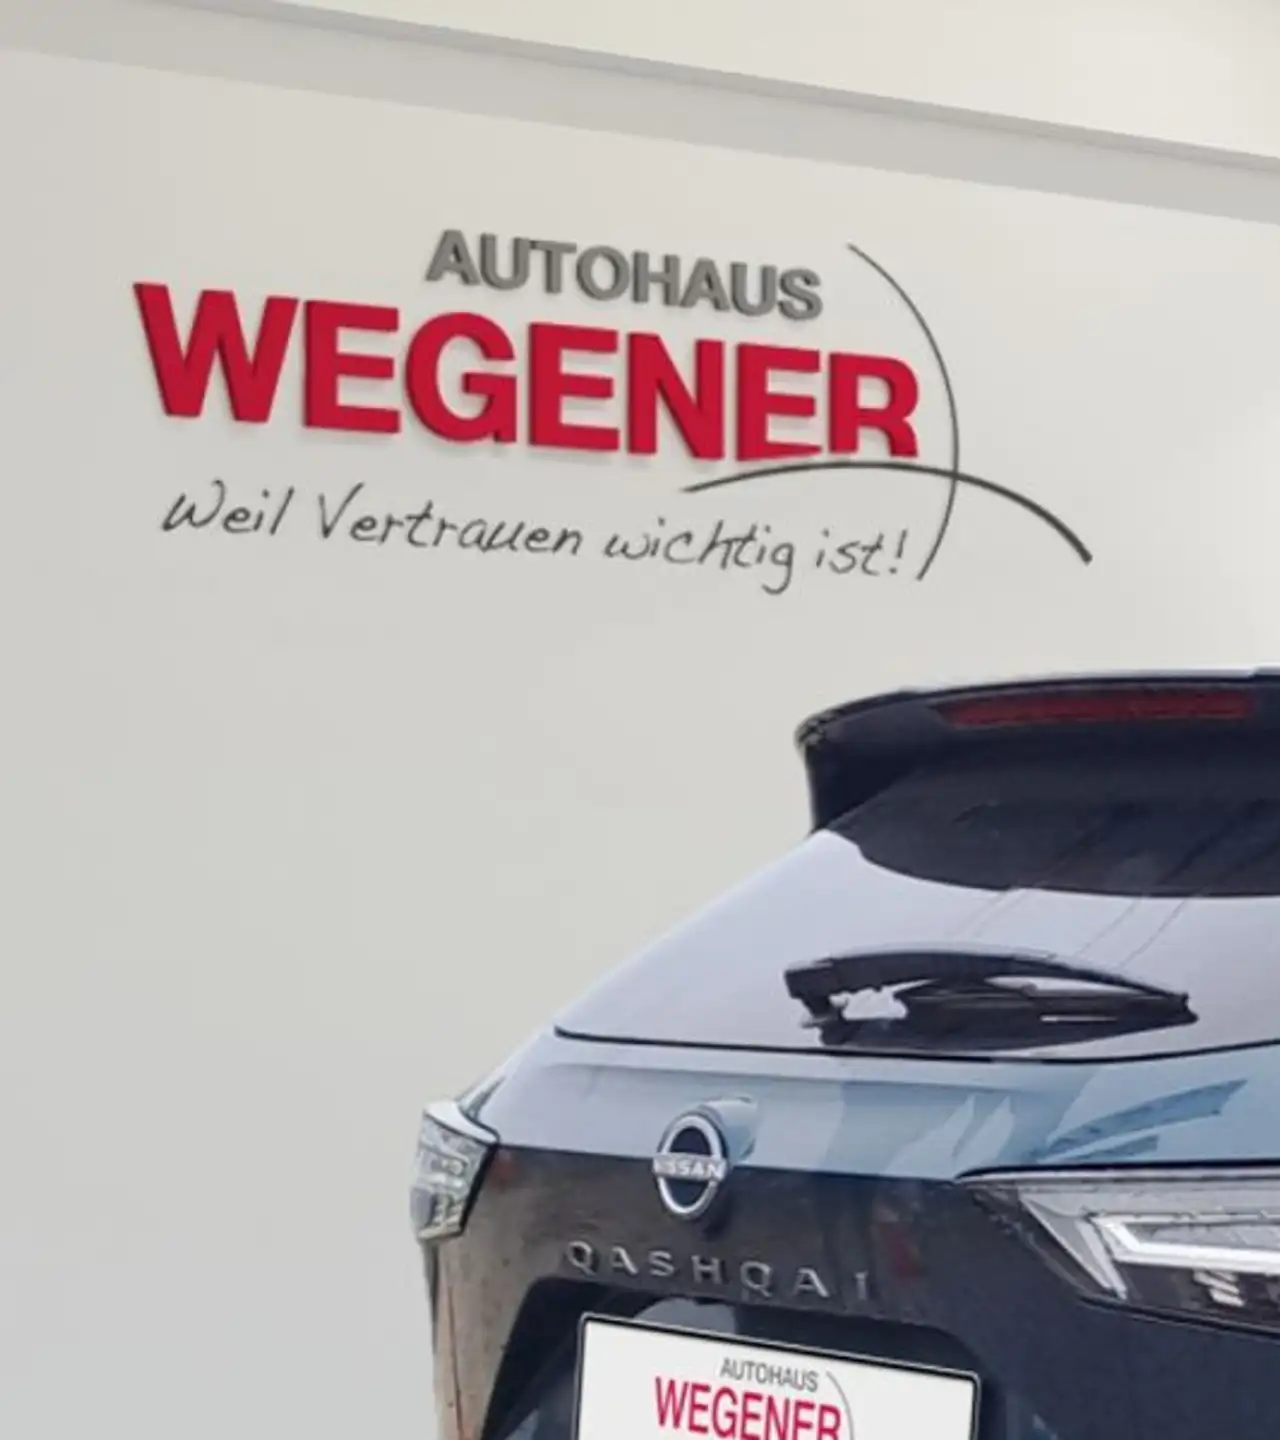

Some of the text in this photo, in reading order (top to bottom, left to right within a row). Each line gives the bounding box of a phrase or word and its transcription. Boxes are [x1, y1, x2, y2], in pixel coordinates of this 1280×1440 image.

[424, 229, 823, 321] AUTOHAUS
[133, 282, 920, 463] WEGENER
[162, 480, 907, 594] Weil Vertrauen wichtig ist!
[567, 1240, 869, 1299] QASHQAI
[720, 1357, 819, 1392] AUTOHAUS
